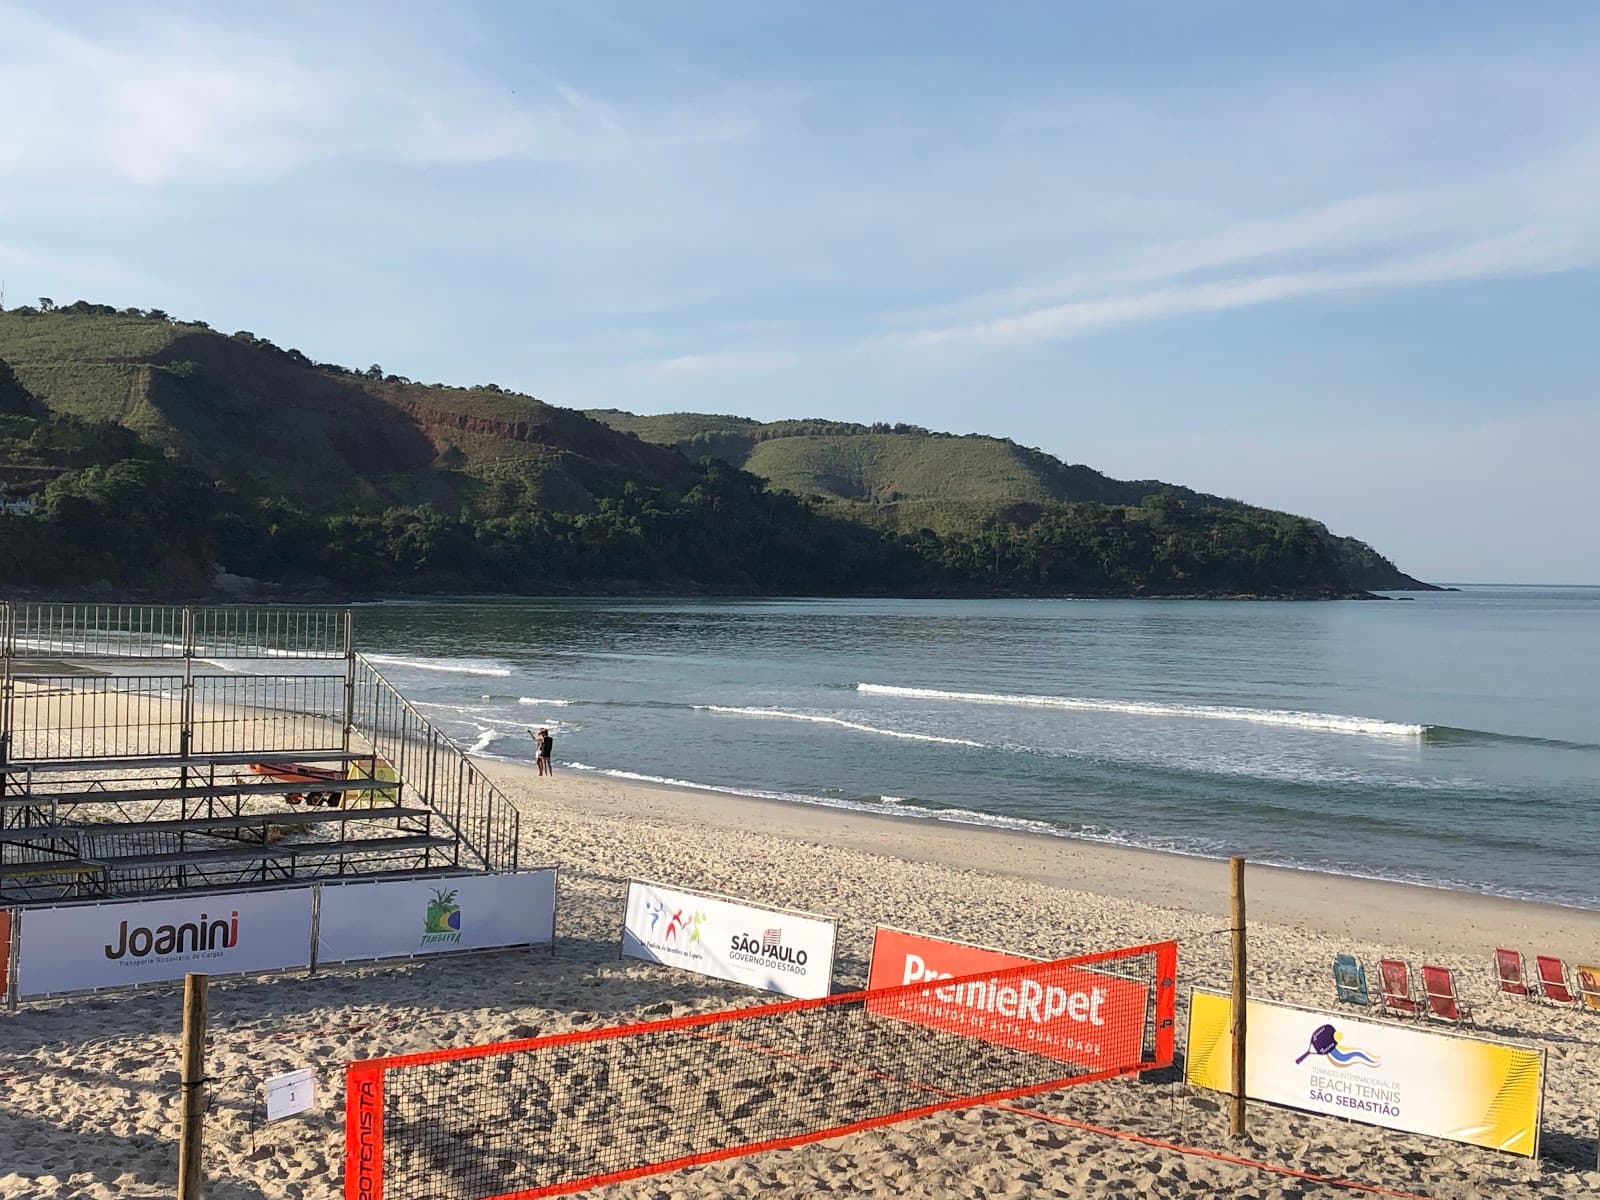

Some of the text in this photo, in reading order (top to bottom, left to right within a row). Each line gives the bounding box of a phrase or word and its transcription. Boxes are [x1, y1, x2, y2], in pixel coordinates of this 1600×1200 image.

[105, 911, 239, 959] Joanini
[731, 932, 808, 966] SÃO PAULO
[729, 951, 765, 966] GOVERNO
[765, 959, 777, 969] DO
[777, 962, 807, 976] ESTADO
[290, 1091, 296, 1102] 1
[1310, 1075, 1401, 1105] BEACH TENNIS
[1310, 1088, 1401, 1118] SÃO SEBASTIÃO
